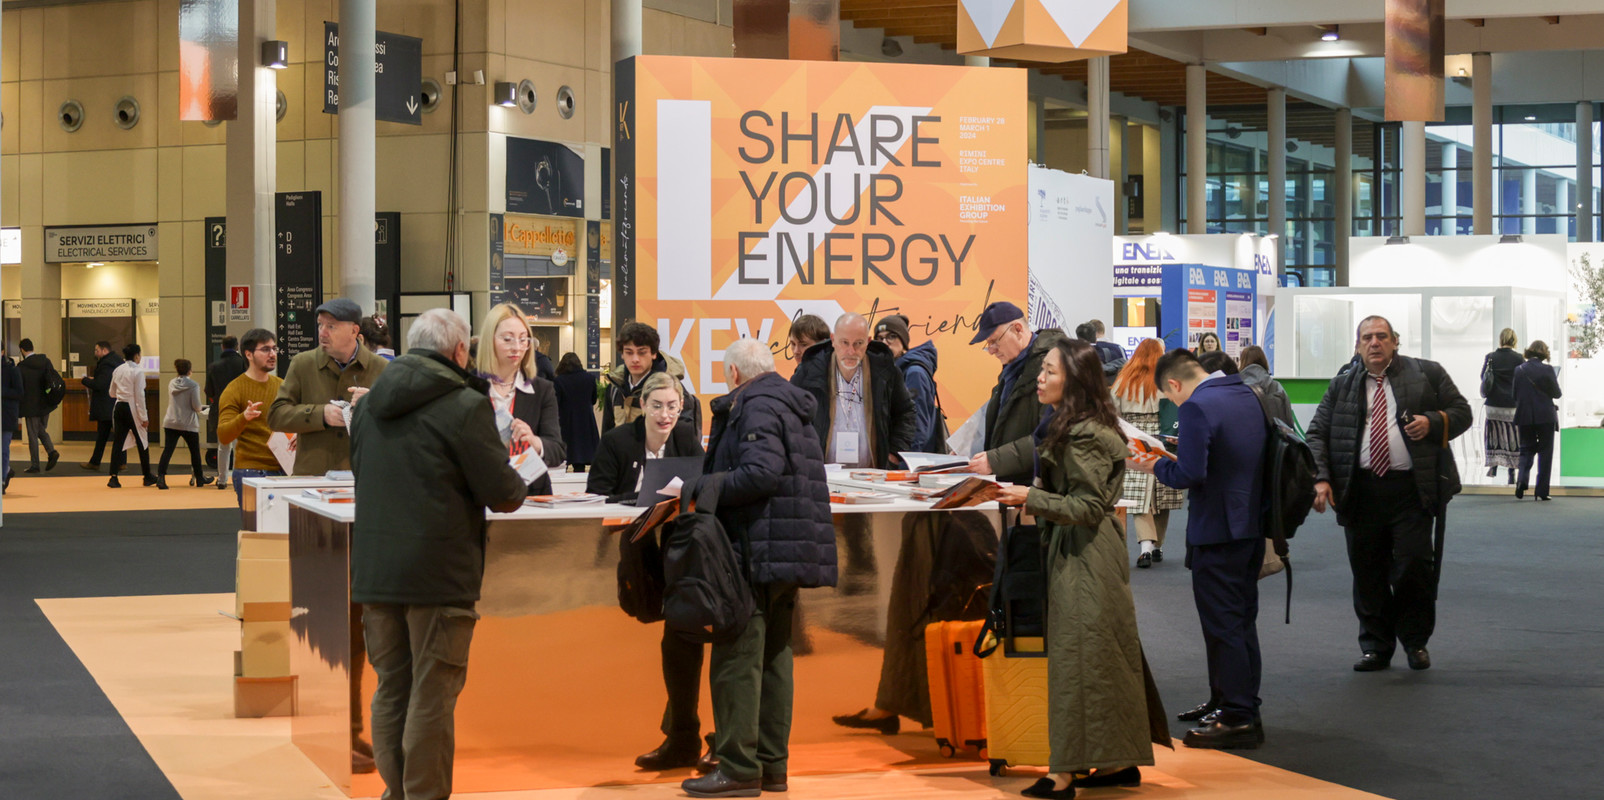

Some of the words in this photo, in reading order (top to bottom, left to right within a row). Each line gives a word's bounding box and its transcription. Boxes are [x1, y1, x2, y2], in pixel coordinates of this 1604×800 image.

[960, 116, 995, 124] FEBRUARY
[738, 110, 941, 167] SHARE
[738, 171, 905, 226] YOUR
[960, 203, 1005, 212] EXHIBITION
[960, 211, 988, 219] GROUP
[60, 235, 95, 246] SERVIZI
[97, 234, 145, 245] ELETTRICI
[286, 231, 292, 242] D
[58, 248, 106, 258] ELECTRICAL
[107, 246, 147, 257] SERVICES
[286, 244, 292, 255] B
[737, 231, 977, 286] ENERGY
[1254, 253, 1272, 275] ENEA
[1189, 267, 1206, 285] ENEA
[1214, 270, 1229, 287] ENEA
[1237, 272, 1252, 289] ENEA
